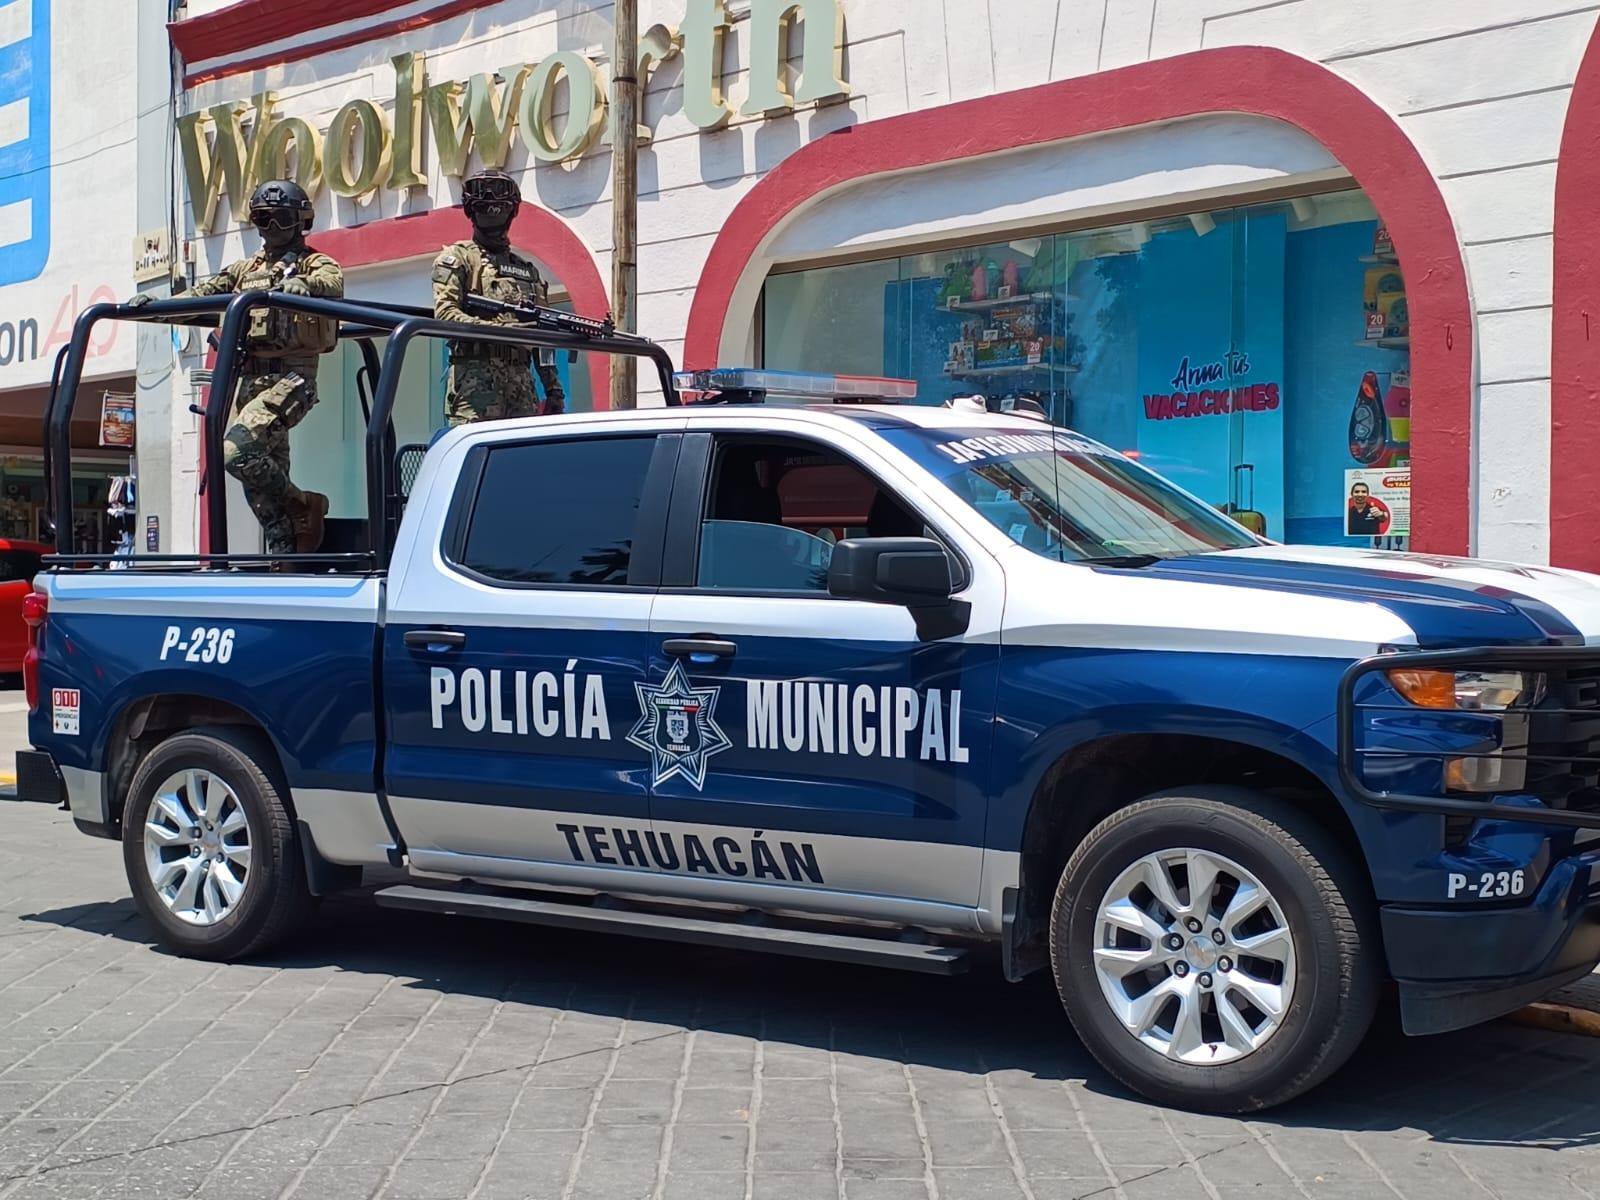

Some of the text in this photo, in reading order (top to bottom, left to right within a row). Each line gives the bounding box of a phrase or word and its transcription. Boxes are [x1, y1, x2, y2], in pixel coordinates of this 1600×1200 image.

[177, 0, 850, 232] Woolworth
[242, 279, 270, 290] MARINA
[500, 264, 530, 278] MARINA
[1370, 314, 1384, 325] 20
[1029, 341, 1041, 352] 20
[1171, 357, 1223, 391] Arma
[159, 625, 236, 665] P-236
[55, 691, 78, 706] 911
[430, 659, 611, 741] POLICÍA
[747, 680, 969, 763] MUNICIPAL
[556, 823, 825, 885] TEHUACÁN
[1447, 869, 1525, 898] P-236
